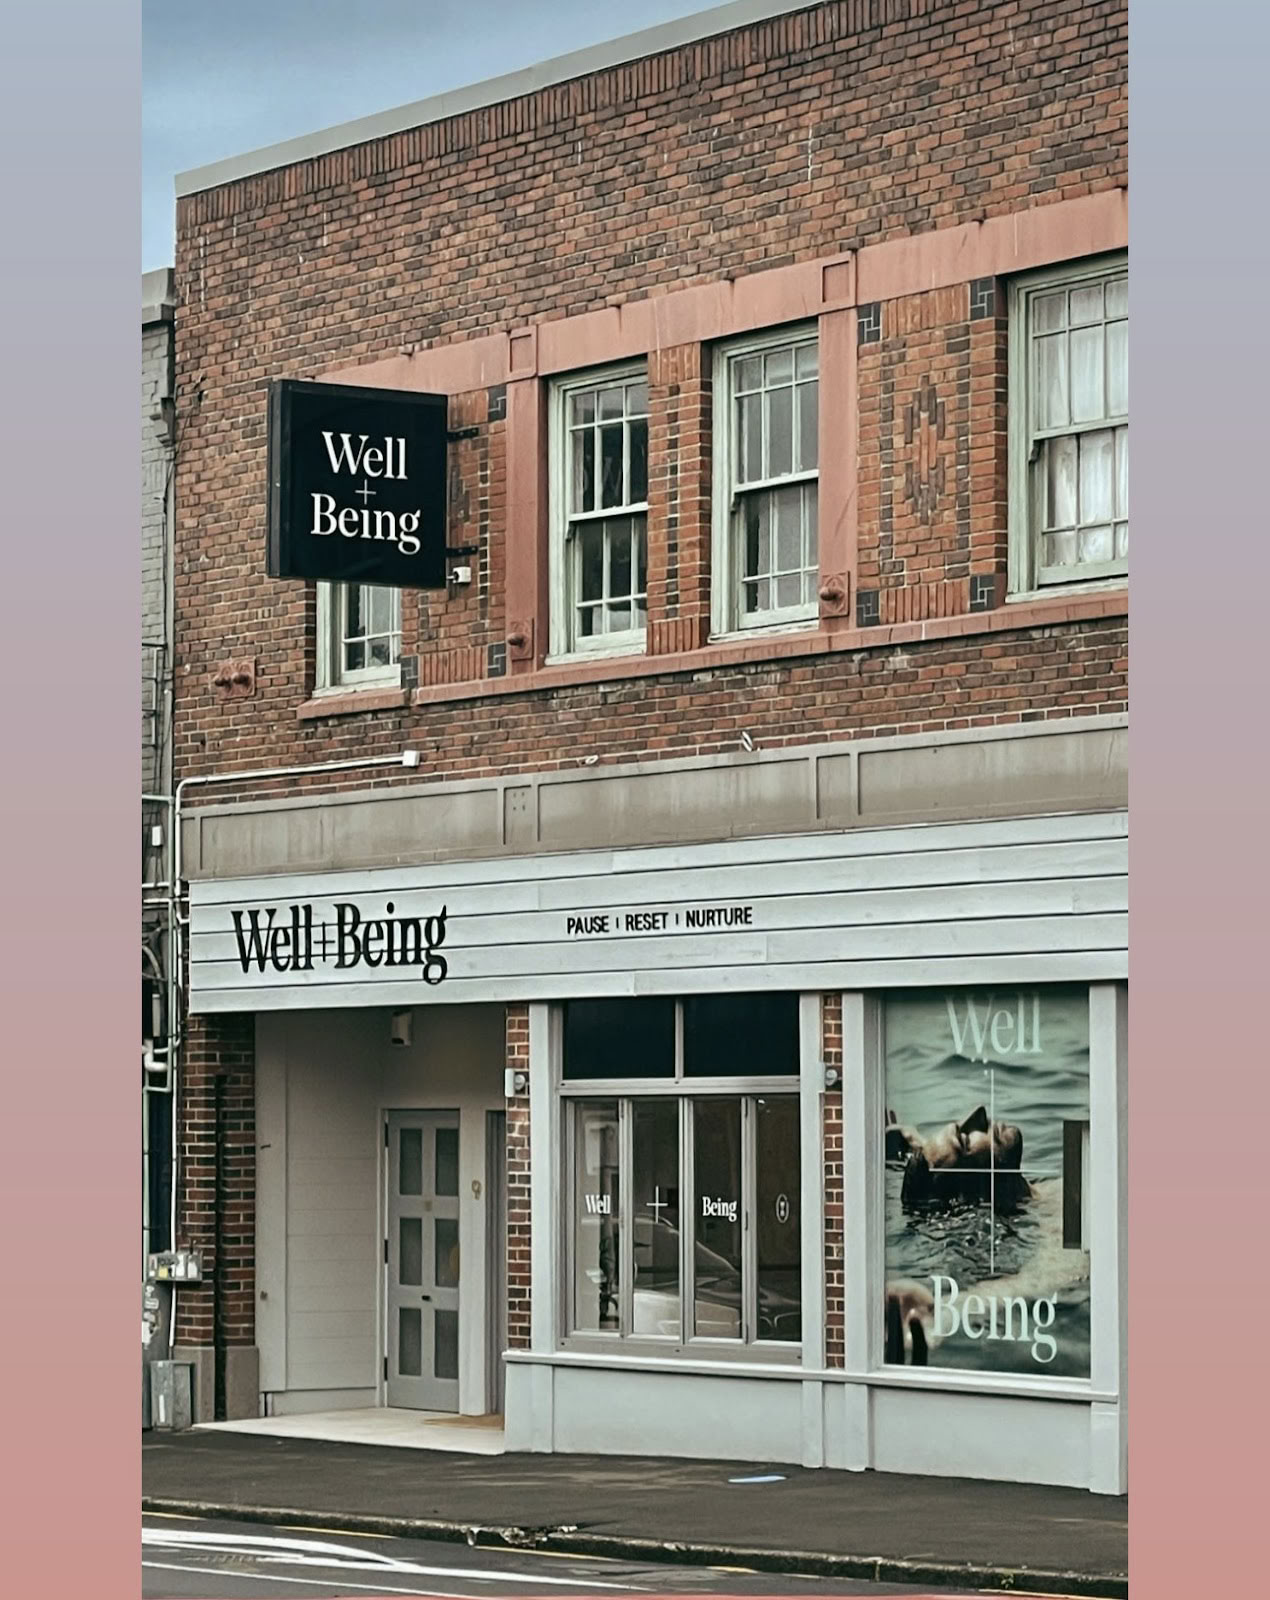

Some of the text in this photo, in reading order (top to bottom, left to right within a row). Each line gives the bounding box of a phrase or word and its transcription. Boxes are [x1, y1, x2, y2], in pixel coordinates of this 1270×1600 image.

[321, 431, 408, 480] Well
[310, 493, 421, 555] Being
[567, 915, 610, 934] PAUSE
[625, 912, 669, 932] RESET
[686, 906, 753, 928] NURTURE
[945, 991, 1043, 1054] Well
[585, 1194, 611, 1214] Well
[702, 1196, 738, 1222] Being
[930, 1275, 1058, 1363] Being
